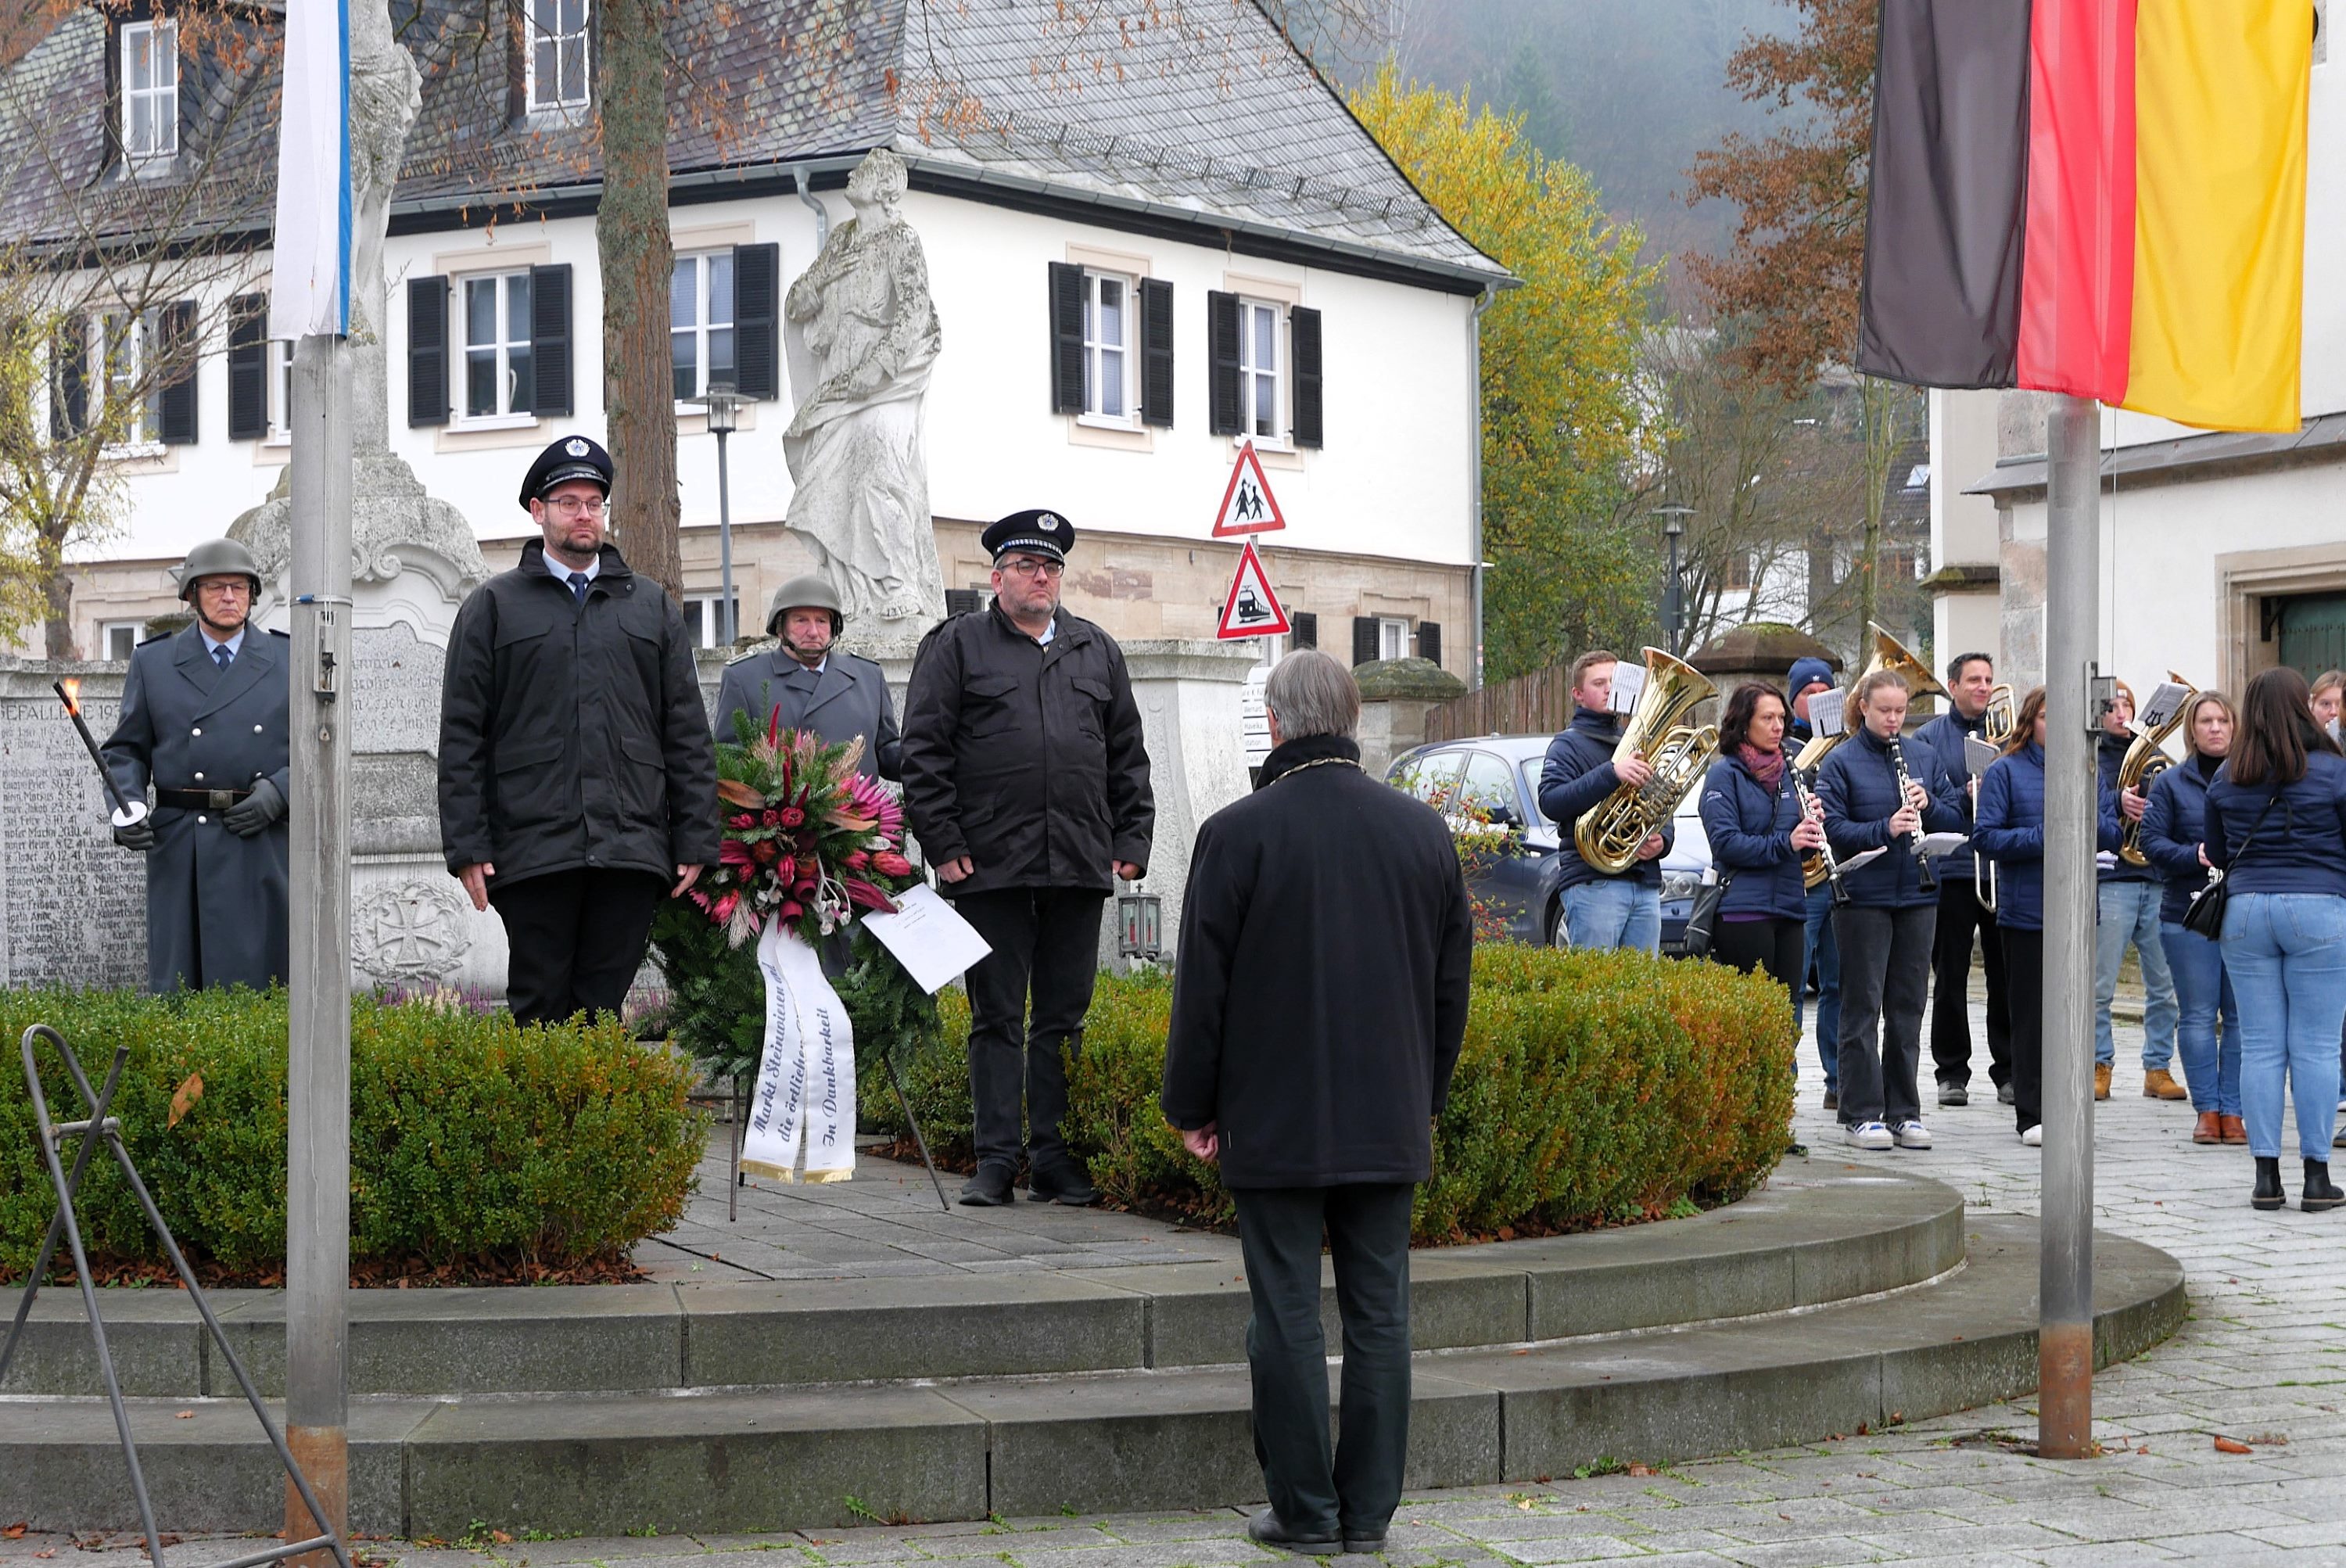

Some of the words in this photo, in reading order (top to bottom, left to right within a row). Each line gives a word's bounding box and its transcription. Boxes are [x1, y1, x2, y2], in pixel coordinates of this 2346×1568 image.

[0, 704, 94, 720] EFALLEE
[753, 1081, 777, 1137] Markt
[765, 986, 786, 1078] Steinwiesen
[816, 1007, 838, 1118] Dankbarkeit
[777, 1117, 795, 1143] die
[823, 1122, 837, 1147] In
